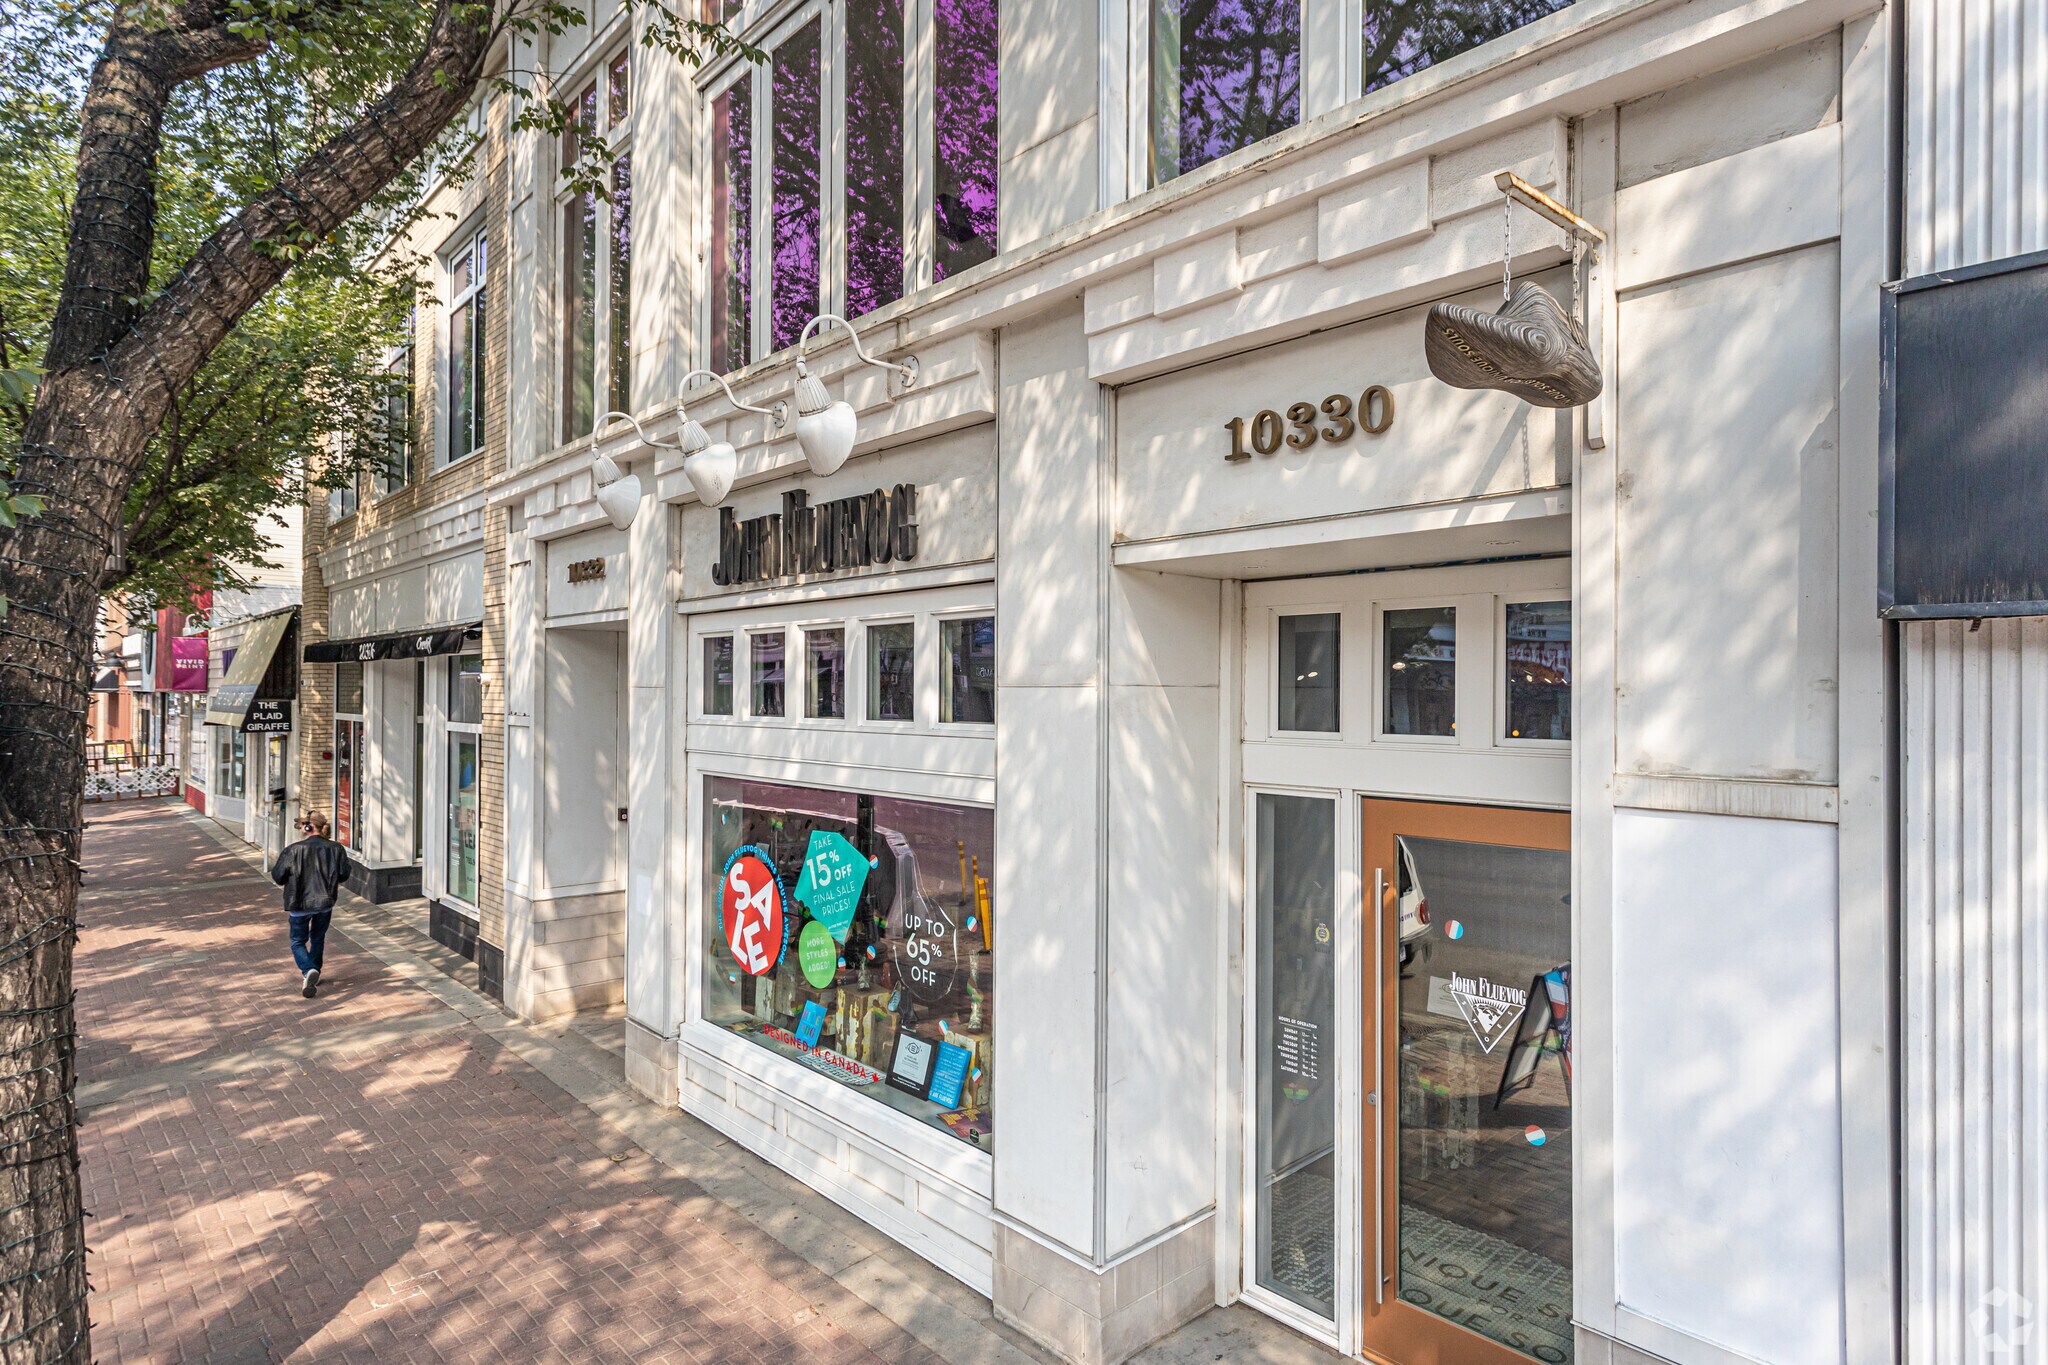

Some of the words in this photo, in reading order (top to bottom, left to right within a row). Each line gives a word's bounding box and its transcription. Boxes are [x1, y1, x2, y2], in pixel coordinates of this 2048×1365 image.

[1441, 327, 1475, 359] SOULS
[1224, 385, 1394, 461] 10330
[712, 506, 782, 585] JOHN
[780, 483, 919, 576] FLUEVOG
[253, 712, 283, 720] PLAID
[258, 701, 278, 710] THE
[247, 722, 290, 731] GIRAFFE
[734, 844, 758, 857] FLUEVOG
[814, 834, 833, 851] TAKE
[723, 853, 735, 875] JOHN
[758, 848, 778, 875] THINKS
[806, 849, 840, 890] 15%
[834, 864, 852, 881] OFF
[776, 874, 789, 913] YOU'RE
[813, 890, 835, 906] FINAL
[836, 880, 856, 897] SALE
[822, 898, 851, 916] PRICES!
[729, 863, 774, 975] SALE
[905, 913, 921, 931] UP
[925, 919, 945, 938] TO
[778, 916, 789, 966] AWESOME
[806, 936, 825, 948] MORE
[906, 932, 942, 966] 65%
[806, 949, 829, 961] STYLES
[808, 960, 831, 973] ADDED!
[911, 966, 936, 986] OFF
[1449, 972, 1477, 996] JOHN
[1479, 977, 1527, 1006] FLUEVOG
[1278, 1015, 1291, 1023] HOURS
[1296, 1020, 1317, 1029] OPERATION
[763, 1023, 809, 1052] DESIGNED
[811, 1044, 822, 1058] IN
[824, 1051, 867, 1079] CANADA
[1277, 1045, 1298, 1054] WEDNESDAY
[1283, 1040, 1298, 1048] TUESDAY
[1280, 1052, 1298, 1060] THURSDAY
[1280, 1065, 1298, 1074] SATURDAY
[1476, 1298, 1524, 1322] FOR
